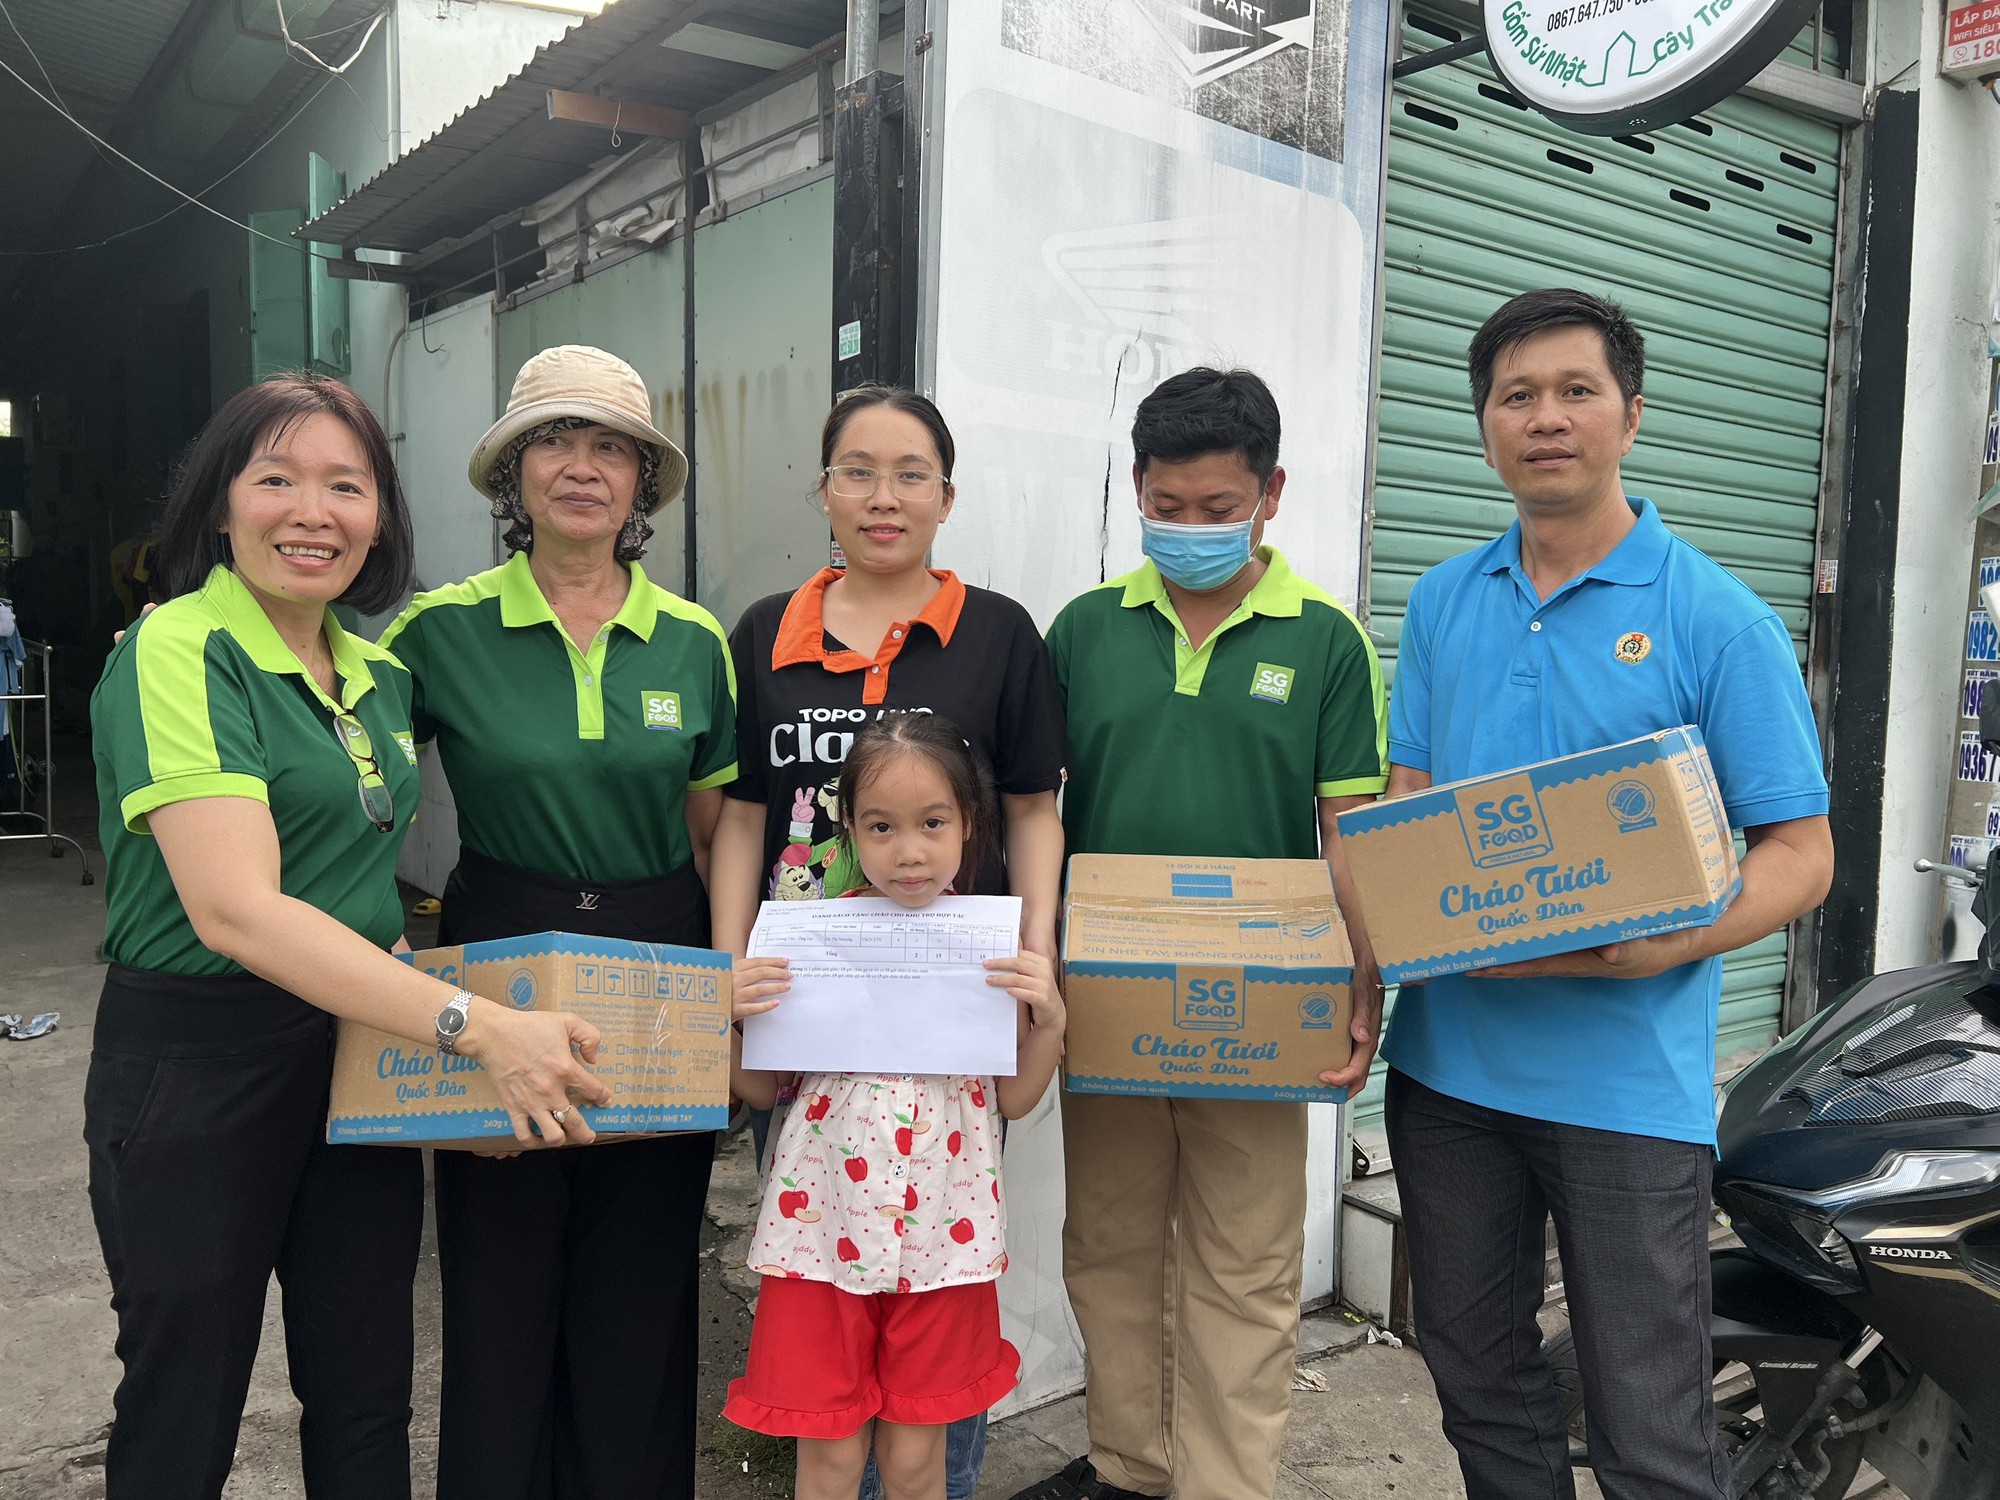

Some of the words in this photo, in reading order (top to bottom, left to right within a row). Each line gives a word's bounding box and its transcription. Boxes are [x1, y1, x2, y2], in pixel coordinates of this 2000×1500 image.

[1955, 10, 1979, 28] LẮP
[1953, 29, 1973, 42] WIFI
[1974, 23, 1995, 37] SIÊU
[1502, 0, 1532, 48] Gốm
[1520, 36, 1549, 66] Sứ
[1539, 49, 1588, 89] Nhật
[1653, 24, 1694, 62] Cây
[1259, 670, 1288, 688] SG
[1255, 682, 1286, 696] FOOD
[648, 698, 677, 714] SG
[648, 713, 678, 723] FOOD
[799, 707, 867, 723] TOPO
[1474, 794, 1533, 831] SG
[1478, 823, 1539, 851] FOOD
[1439, 879, 1525, 918] Cháo
[1525, 857, 1611, 898] Tươi
[1477, 908, 1530, 935] Quốc
[1536, 900, 1584, 921] Dân
[1082, 945, 1105, 953] XIN
[1174, 950, 1228, 959] KHÔNG
[1399, 965, 1429, 979] Không
[1186, 978, 1237, 1003] SG
[1184, 1003, 1237, 1018] FOOD
[1131, 1033, 1207, 1058] Cháo
[1210, 1036, 1280, 1060] Tươi
[376, 1047, 434, 1079] Cháo
[1159, 1060, 1203, 1075] Quốc
[1210, 1062, 1251, 1075] Dân
[876, 1073, 900, 1084] Apple
[396, 1081, 430, 1103] Quốc
[434, 1080, 467, 1097] Dân
[1273, 1091, 1296, 1099] 240g
[679, 1114, 693, 1123] TAY
[803, 1154, 824, 1165] Apple
[845, 1206, 868, 1218] Apple
[1869, 1245, 1952, 1260] HONDA
[958, 1268, 982, 1277] Apple
